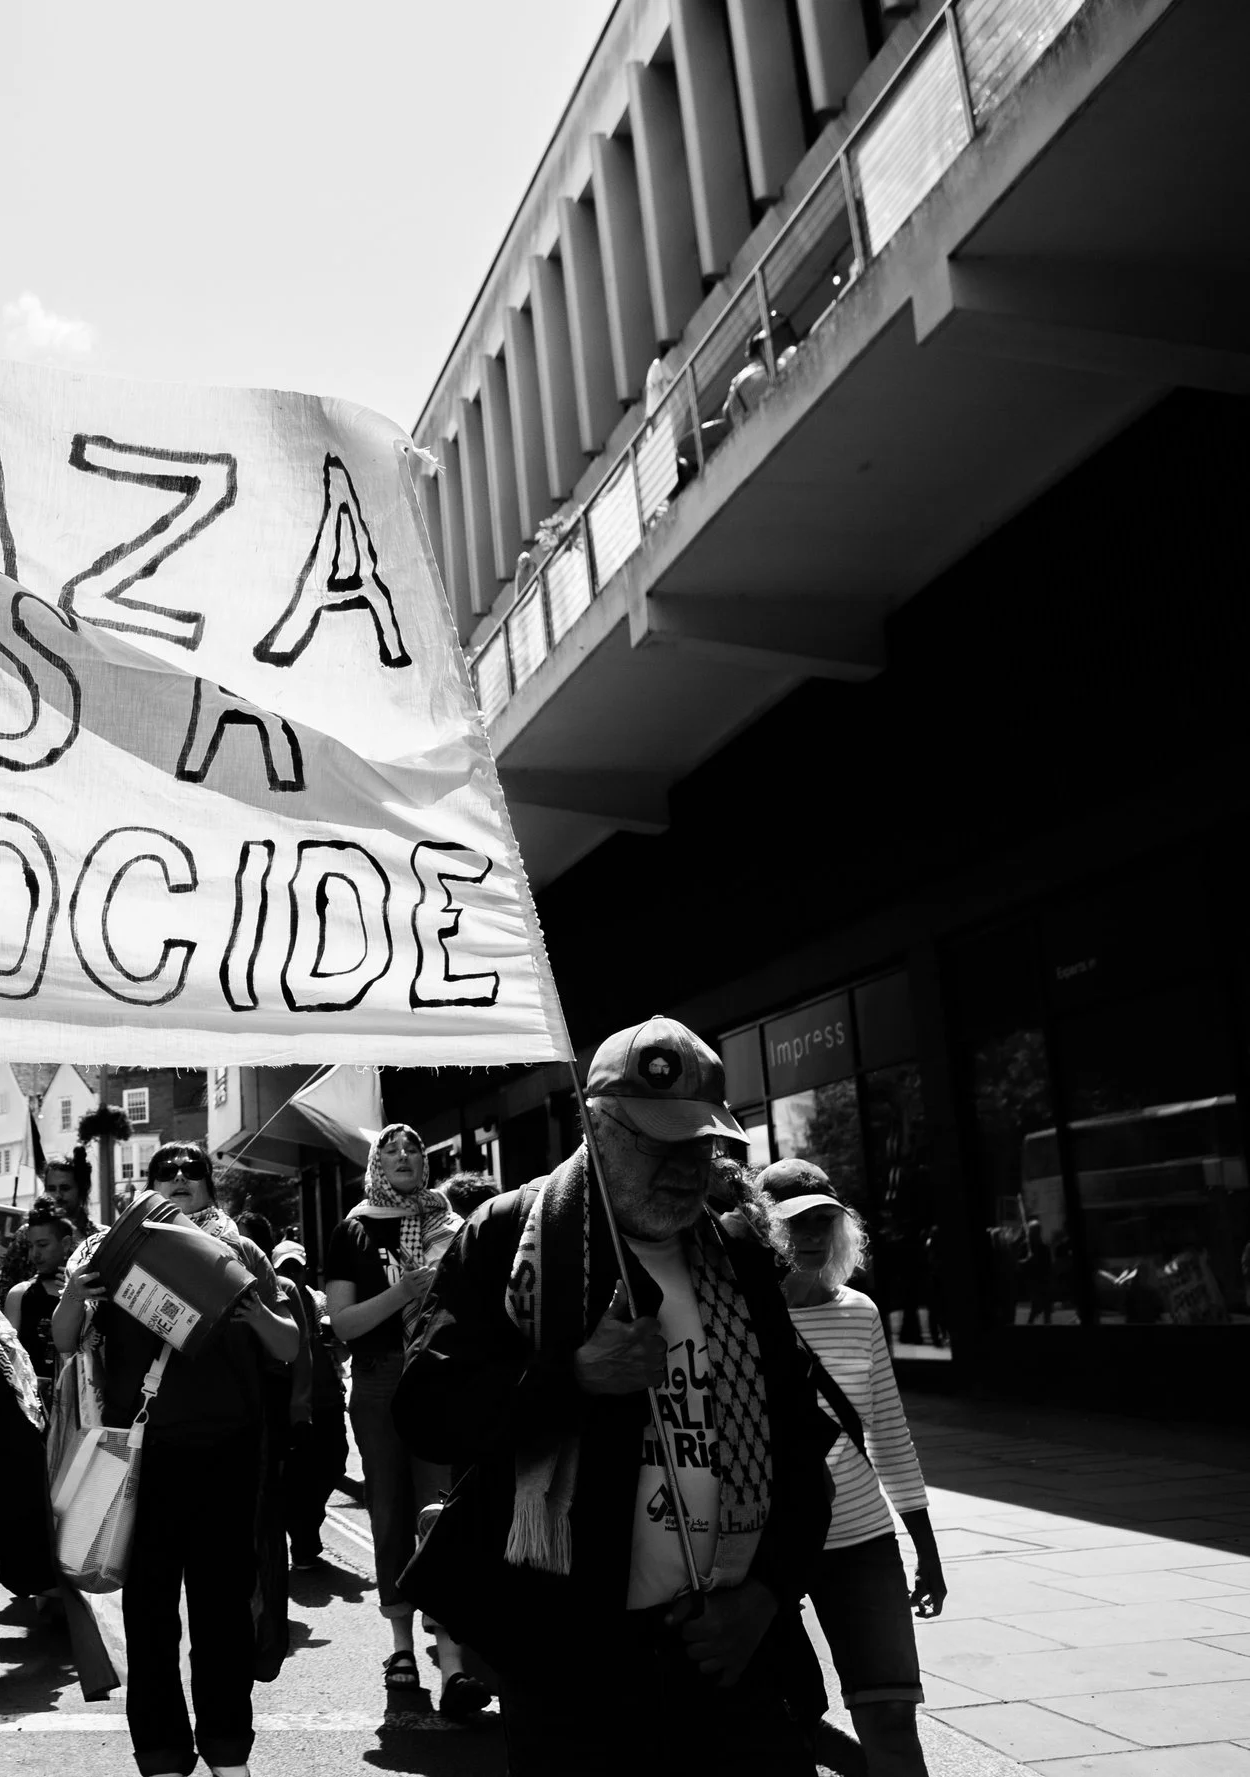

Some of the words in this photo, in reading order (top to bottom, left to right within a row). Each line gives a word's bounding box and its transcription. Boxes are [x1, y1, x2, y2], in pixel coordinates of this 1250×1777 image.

[770, 1021, 845, 1068] Impress
[146, 1312, 160, 1330] SCAN
[152, 1318, 173, 1340] ME
[674, 1430, 721, 1478] Rig
